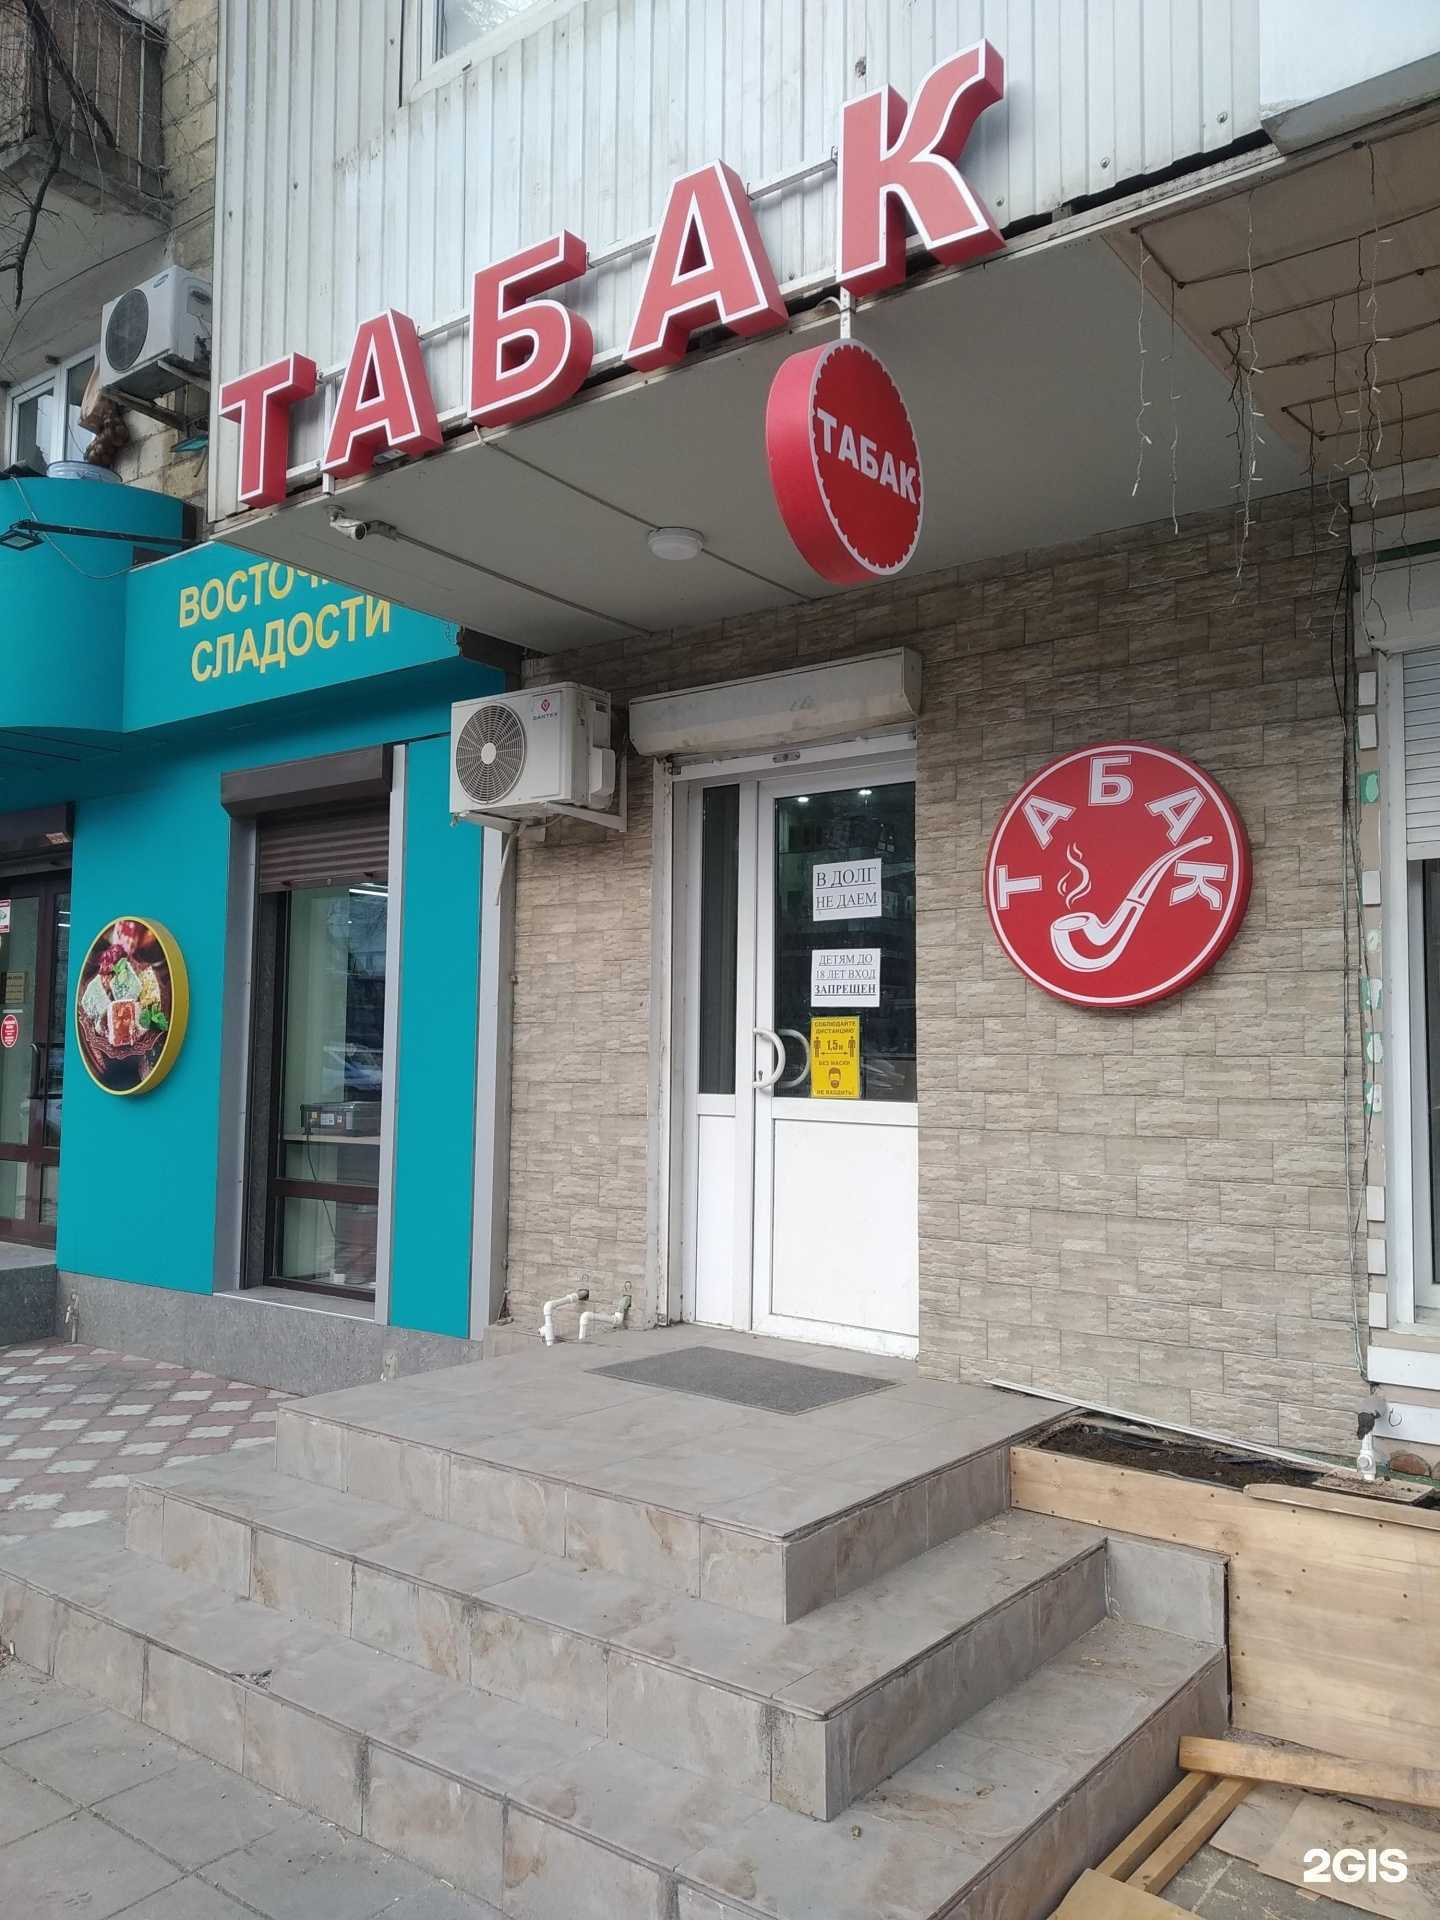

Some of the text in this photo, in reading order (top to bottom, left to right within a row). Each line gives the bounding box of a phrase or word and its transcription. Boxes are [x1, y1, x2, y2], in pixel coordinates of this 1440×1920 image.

[219, 38, 1004, 508] ТАБАК
[816, 407, 917, 505] ТАБАК
[179, 560, 329, 628] ВОСТО
[191, 594, 391, 683] СЛАДОСТИ
[996, 754, 1228, 910] ТАБАК
[816, 866, 877, 888] В ДОЛГ
[816, 892, 878, 909] НЕ ДАЕМ
[816, 969, 876, 980] 18 ЛЕТ ВХОД
[819, 953, 873, 966] ДЕТЯМ ДО
[814, 984, 876, 994] ЗАПРЕЩЕН
